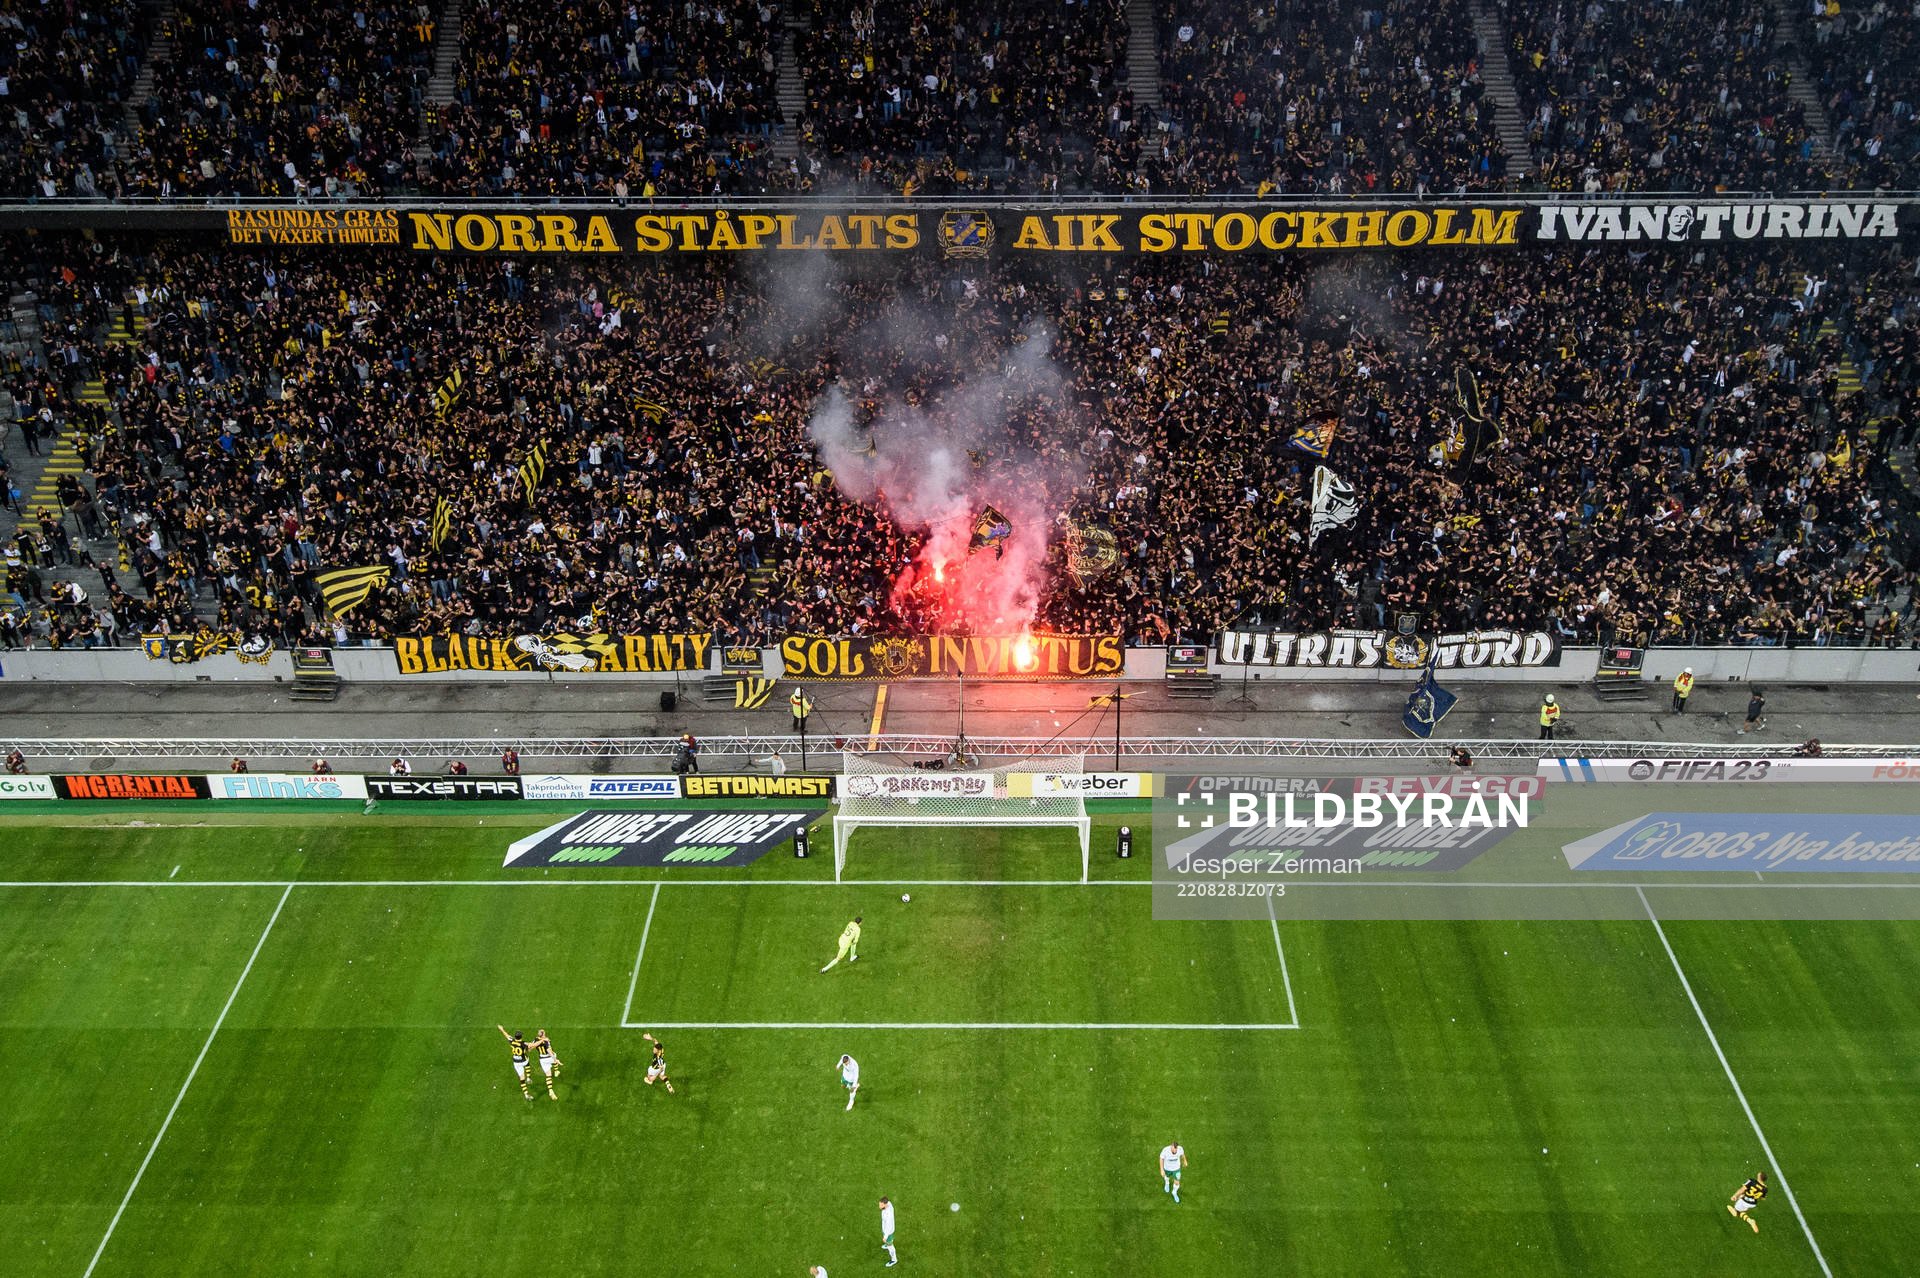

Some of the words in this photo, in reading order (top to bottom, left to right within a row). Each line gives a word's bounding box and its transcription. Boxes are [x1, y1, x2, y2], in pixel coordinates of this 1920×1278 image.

[408, 213, 622, 252] NORRA
[637, 210, 921, 252] STÅPLATS
[1012, 214, 1124, 252] AIK
[1139, 208, 1523, 252] STOCKHOLM
[1537, 206, 1670, 240] IVAN
[1697, 205, 1899, 239] TURINA
[231, 229, 262, 243] DET
[338, 228, 400, 243] HIMLEN
[395, 632, 519, 674] BLACK
[600, 631, 712, 671] ARMY
[783, 636, 865, 676] SOL
[929, 635, 1121, 675] INVICTUS
[1220, 630, 1386, 668] ULTRAS
[1428, 631, 1554, 668] NORD
[1656, 761, 1726, 781] FIFA
[1728, 761, 1771, 781] 23
[0, 780, 46, 793] Golv
[223, 776, 343, 798] Flinks
[369, 779, 519, 796] TEXSTAR
[526, 783, 583, 792] Takprodukter
[527, 791, 567, 799] Norden
[590, 782, 676, 793] KATEPAL
[686, 776, 830, 796] BETONMAST
[1198, 776, 1321, 792] OPTIMERA
[1360, 776, 1540, 798] BEVEGO
[561, 814, 693, 843] UNIBET
[675, 814, 807, 843] UNIBET
[1661, 832, 1770, 859] OBOS
[1753, 832, 1830, 869] Nya
